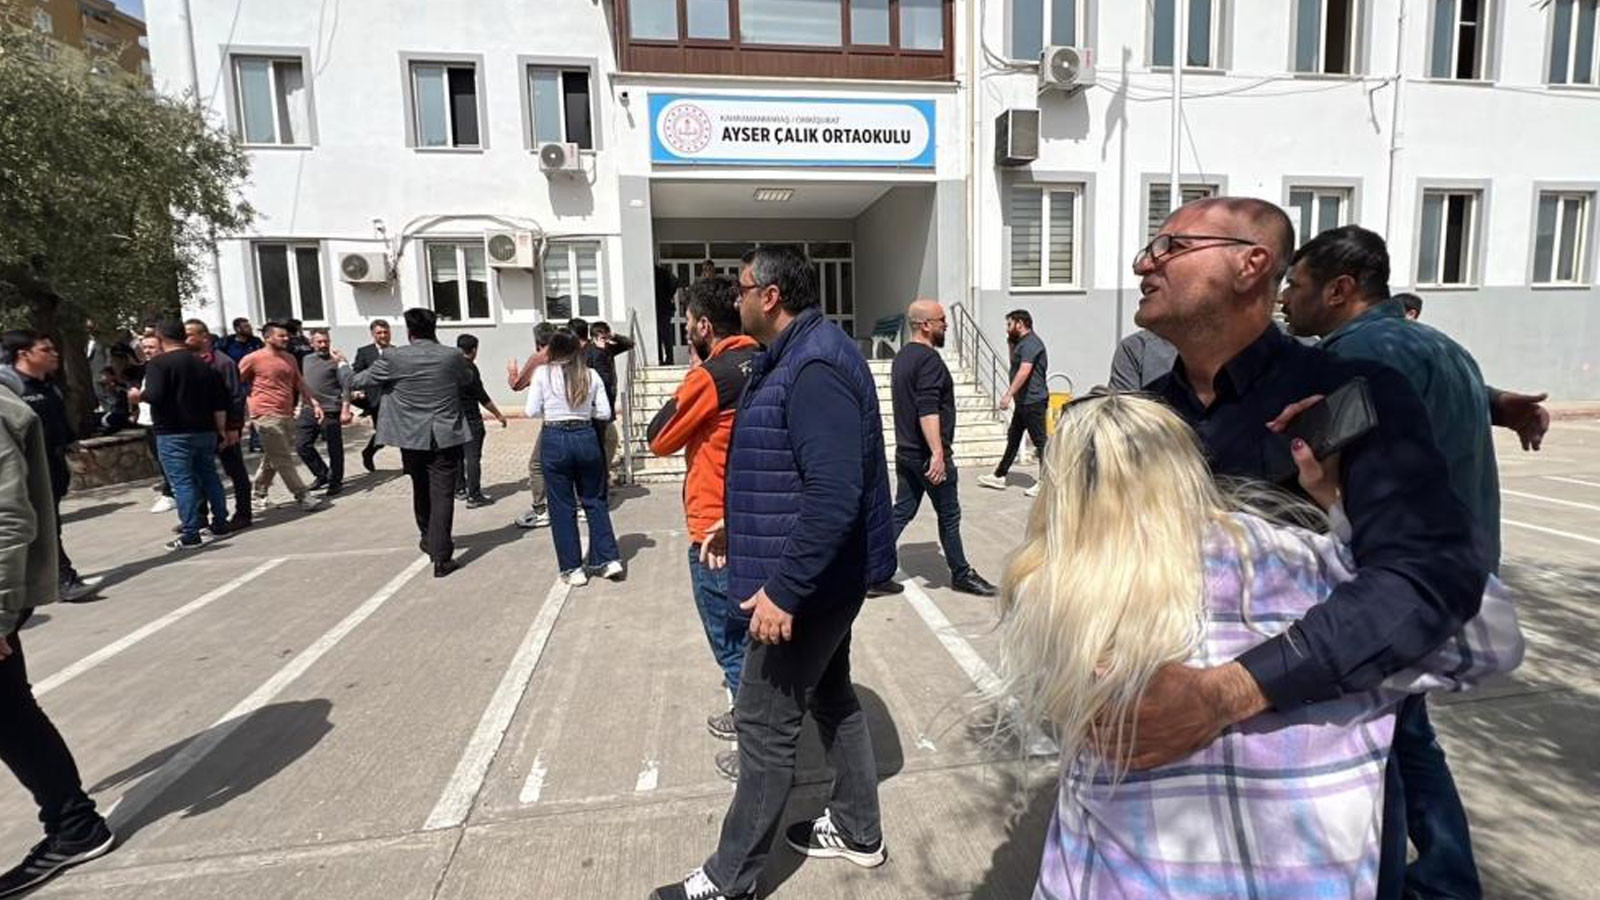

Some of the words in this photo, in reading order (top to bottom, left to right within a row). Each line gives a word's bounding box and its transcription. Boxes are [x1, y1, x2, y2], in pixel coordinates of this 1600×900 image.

[721, 126, 770, 142] AYSER
[774, 127, 818, 145] ÇALIK
[822, 128, 911, 145] ORTAOKULU
